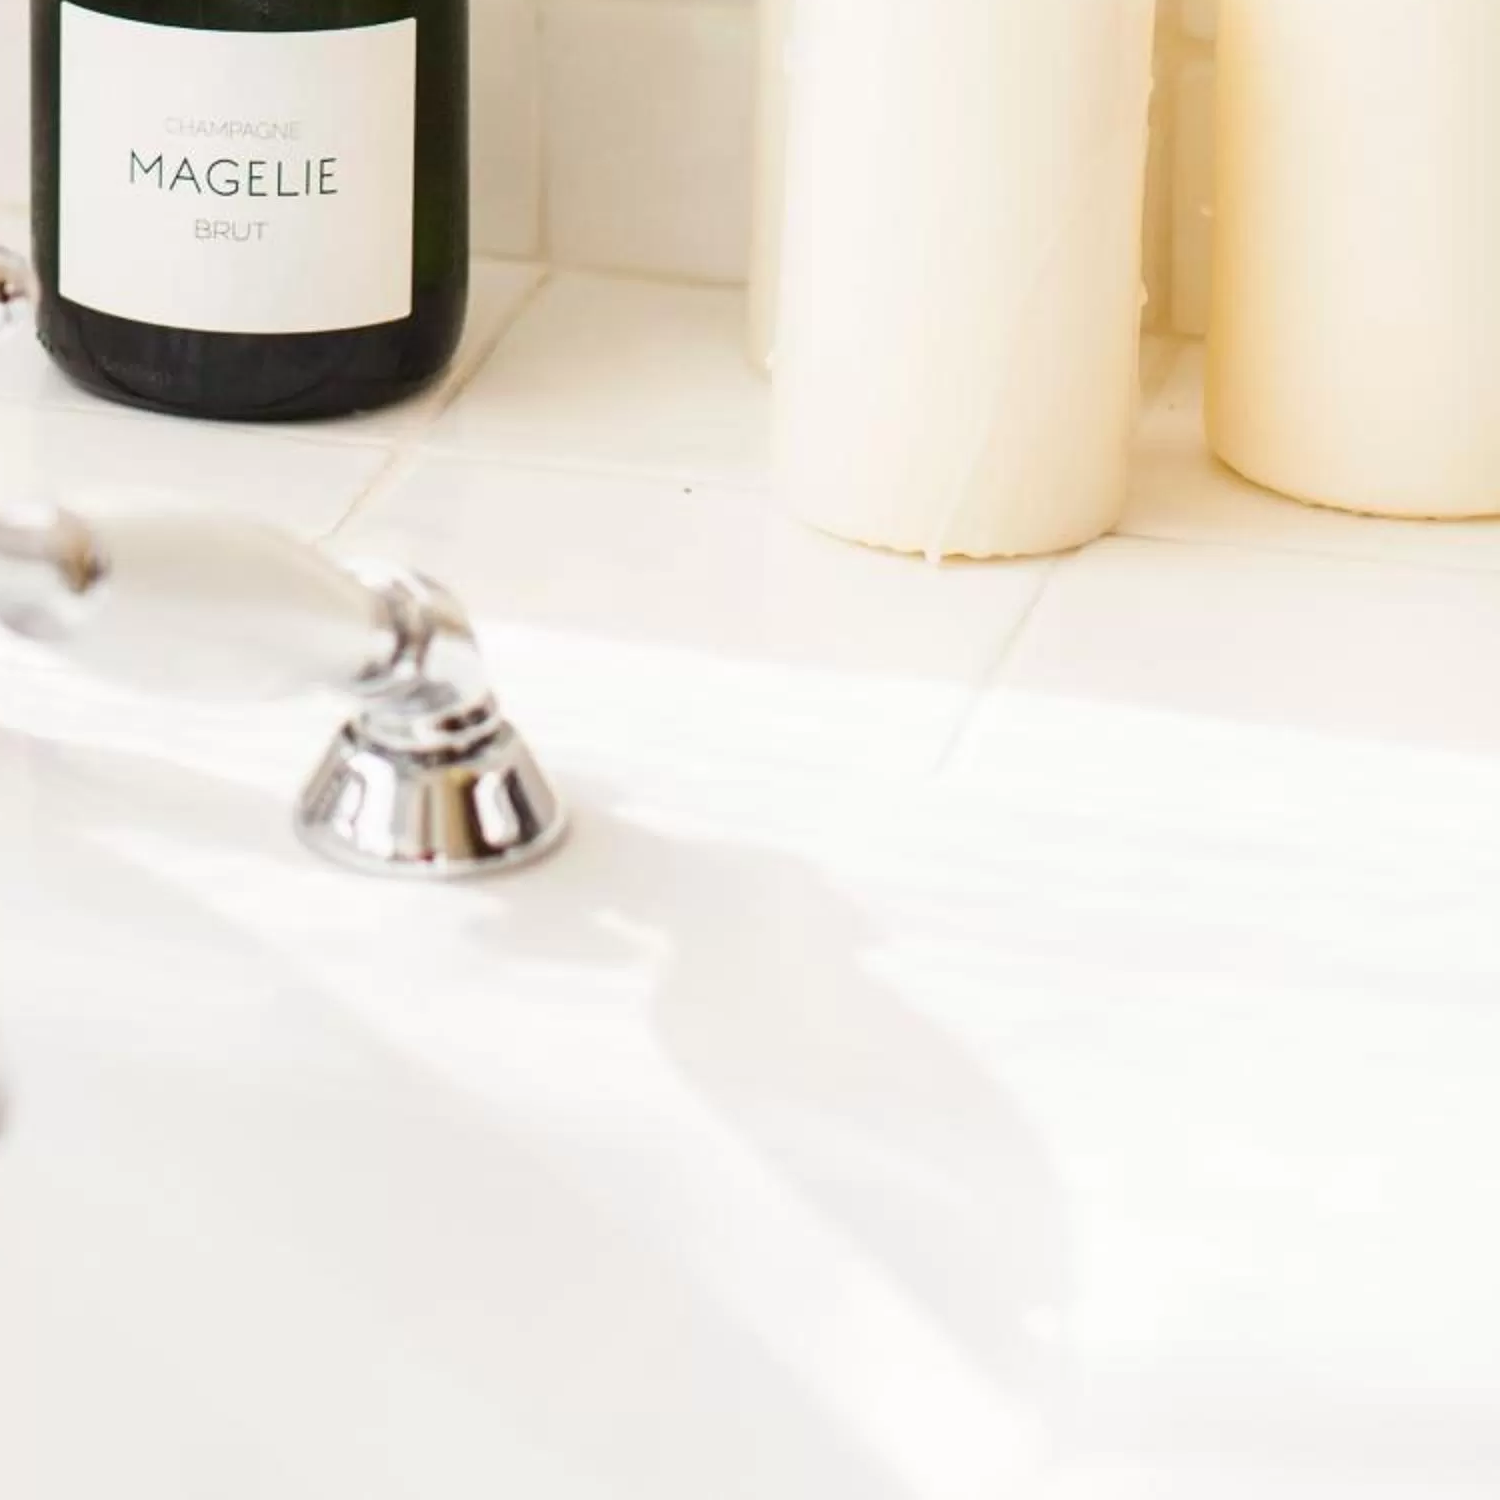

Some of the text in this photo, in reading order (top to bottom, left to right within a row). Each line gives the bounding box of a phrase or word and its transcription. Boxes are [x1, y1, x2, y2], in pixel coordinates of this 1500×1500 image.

[164, 117, 302, 140] CHAMPAGNE
[129, 149, 338, 197] MAGELIE
[195, 218, 268, 242] BRUT
